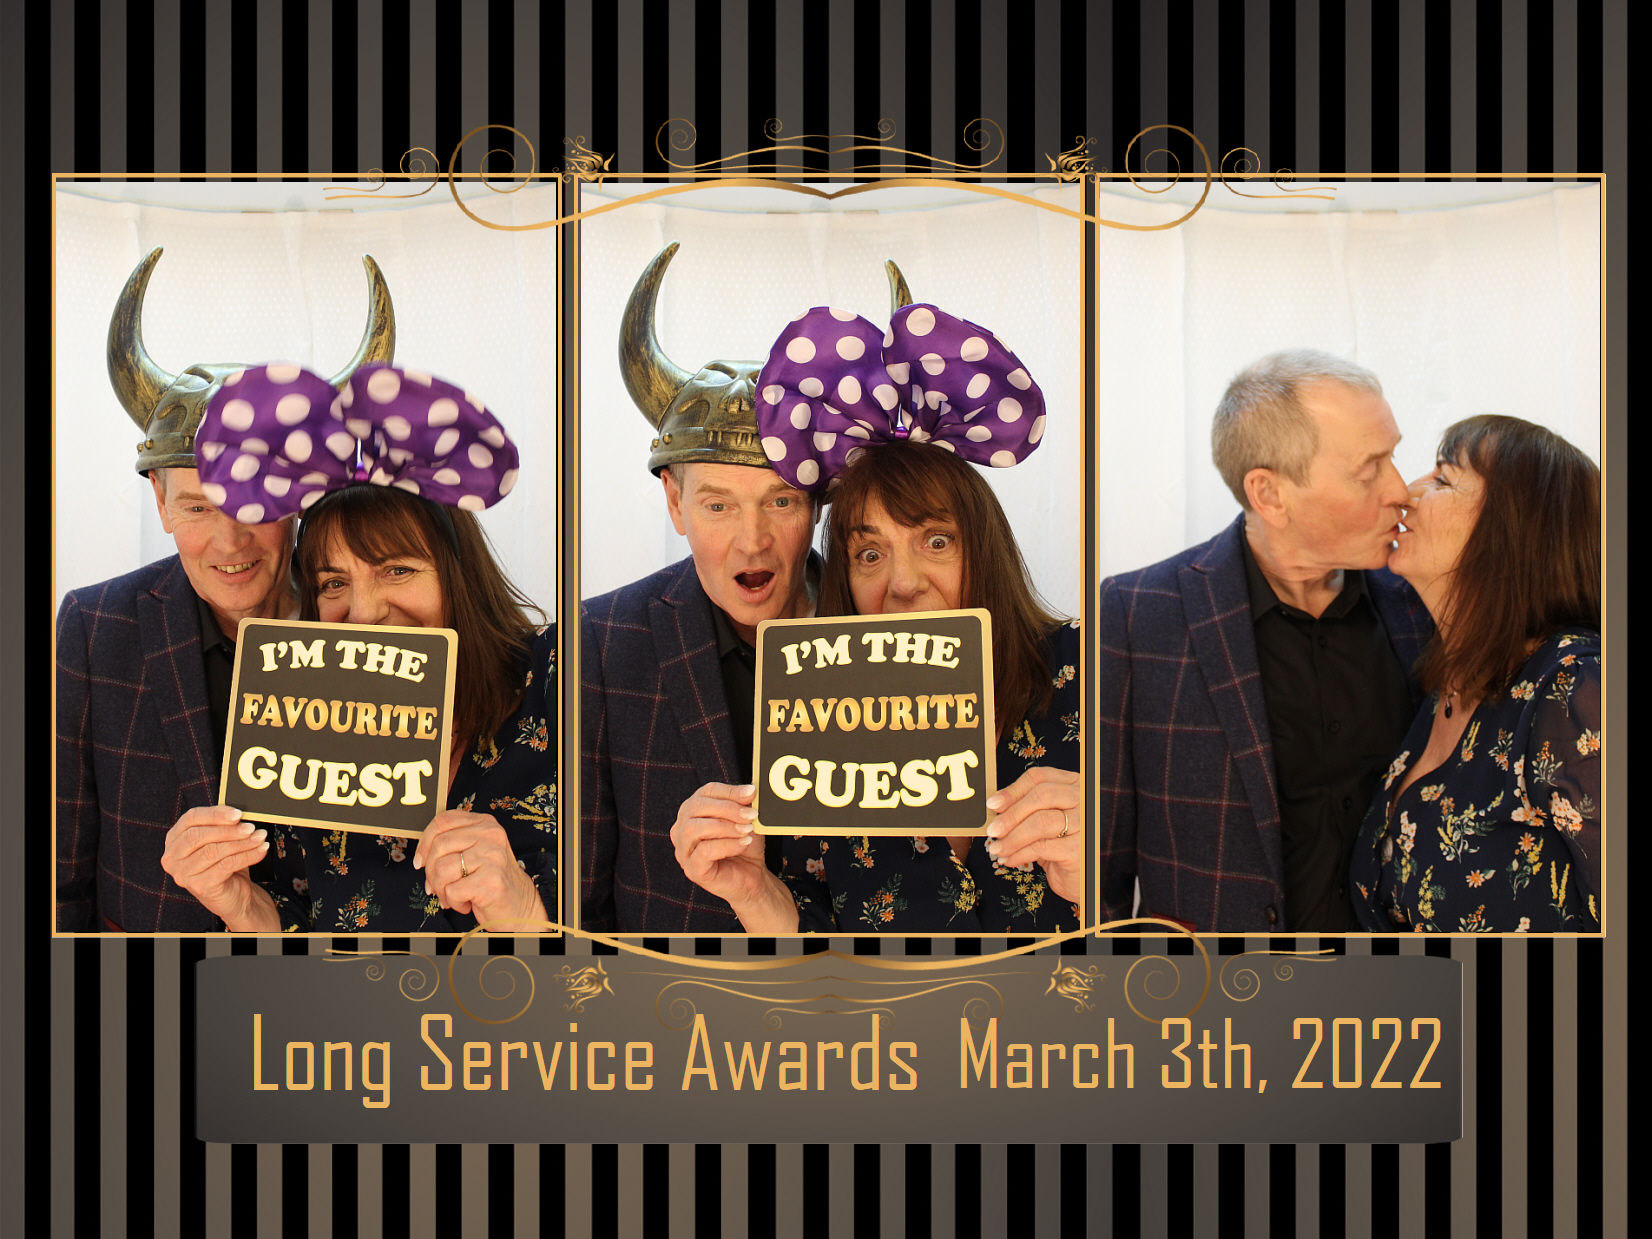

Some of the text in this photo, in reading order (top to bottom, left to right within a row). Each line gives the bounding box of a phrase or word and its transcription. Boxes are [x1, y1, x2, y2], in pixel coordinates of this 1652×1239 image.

[259, 639, 428, 682] I'M THE
[780, 632, 961, 675] I'M THE
[240, 693, 438, 740] FAVOURITE
[767, 693, 979, 732] FAVOURITE
[238, 746, 433, 807] GUEST
[768, 750, 979, 809] GUEST
